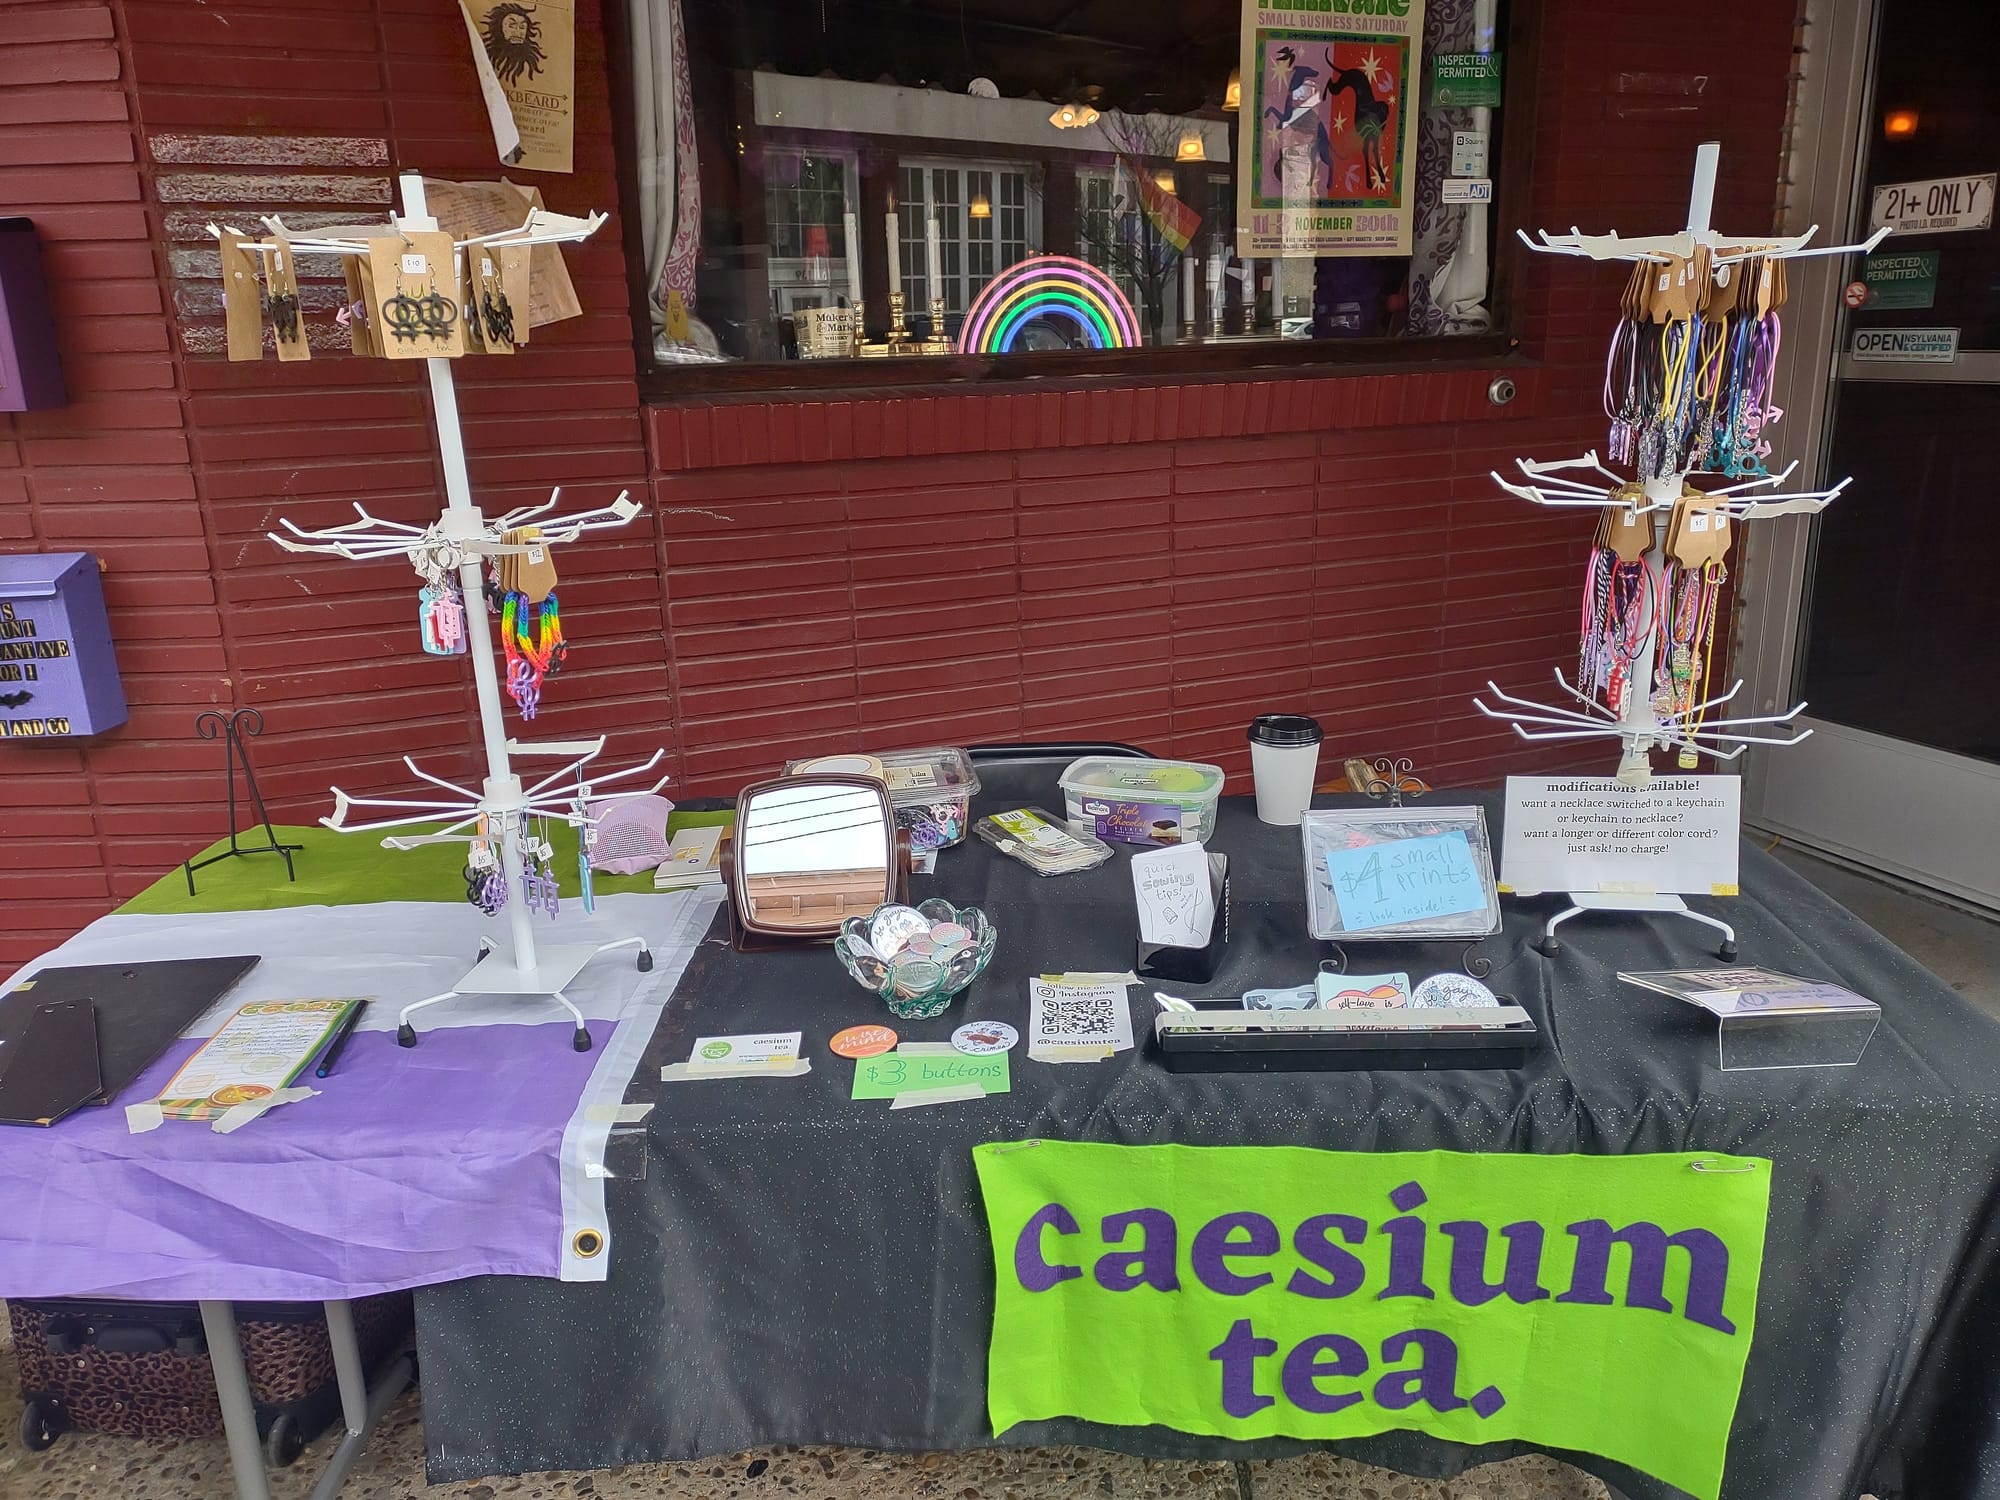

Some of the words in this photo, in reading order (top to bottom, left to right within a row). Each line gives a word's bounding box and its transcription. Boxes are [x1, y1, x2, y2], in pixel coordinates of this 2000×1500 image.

[1258, 12, 1296, 26] SMALL
[1301, 13, 1352, 30] BUSINESS
[1356, 17, 1409, 33] SATURDAY
[1438, 54, 1487, 66] INSPECTED
[1438, 67, 1486, 78] PERMITTED
[506, 90, 560, 109] KBEARD
[1470, 184, 1489, 198] ADT
[1885, 188, 1921, 219] 21+
[1926, 181, 1981, 216] ONLY
[1295, 216, 1353, 231] NOVEMBER
[1900, 219, 1918, 230] PHOTO
[1930, 216, 1958, 228] REQUIRED
[1867, 256, 1921, 270] INSPECTED
[1866, 269, 1919, 281] PERMITTED
[816, 313, 853, 322] Maker's
[827, 323, 853, 332] Mark
[1857, 333, 1904, 351] OPEN
[1904, 334, 1951, 343] NSYLVANIA
[38, 640, 69, 658] AVE
[12, 719, 45, 736] AND
[47, 717, 71, 734] CO
[1639, 780, 1700, 792] ailable!
[1521, 799, 1547, 809] want
[1550, 801, 1557, 809] a
[1560, 798, 1604, 808] necklace
[1606, 799, 1651, 810] switched
[1653, 798, 1664, 808] to
[1666, 800, 1673, 808] a
[1676, 797, 1726, 810] keychain
[1115, 803, 1140, 819] Triple
[1557, 815, 1569, 824] or
[1571, 813, 1619, 826] keychain
[1622, 815, 1633, 825] to
[1635, 813, 1684, 825] necklace?
[1523, 829, 1549, 839] want
[1551, 831, 1558, 839] a
[1561, 828, 1595, 842] longer
[1597, 830, 1609, 839] or
[1611, 828, 1656, 840] different
[1657, 827, 1685, 839] color
[1687, 828, 1719, 840] cord?
[1567, 843, 1587, 855] just
[1589, 843, 1612, 853] ask!
[1614, 845, 1629, 854] no
[1630, 843, 1670, 857] charge!
[1340, 851, 1391, 904] $4
[1391, 840, 1454, 869] small
[1395, 864, 1472, 893] prints
[1156, 886, 1183, 902] tips!
[1370, 908, 1395, 923] look
[1403, 896, 1446, 916] inside!
[1059, 990, 1117, 998] Instagram
[1338, 997, 1375, 1010] self-love
[1384, 999, 1394, 1008] is
[753, 1037, 793, 1045] caesium
[1037, 1038, 1121, 1046] @caesiumtea
[866, 1059, 907, 1086] $3
[922, 1062, 1002, 1080] buttons
[1014, 1180, 1737, 1336] caesium
[1208, 1318, 1507, 1420] tea.
